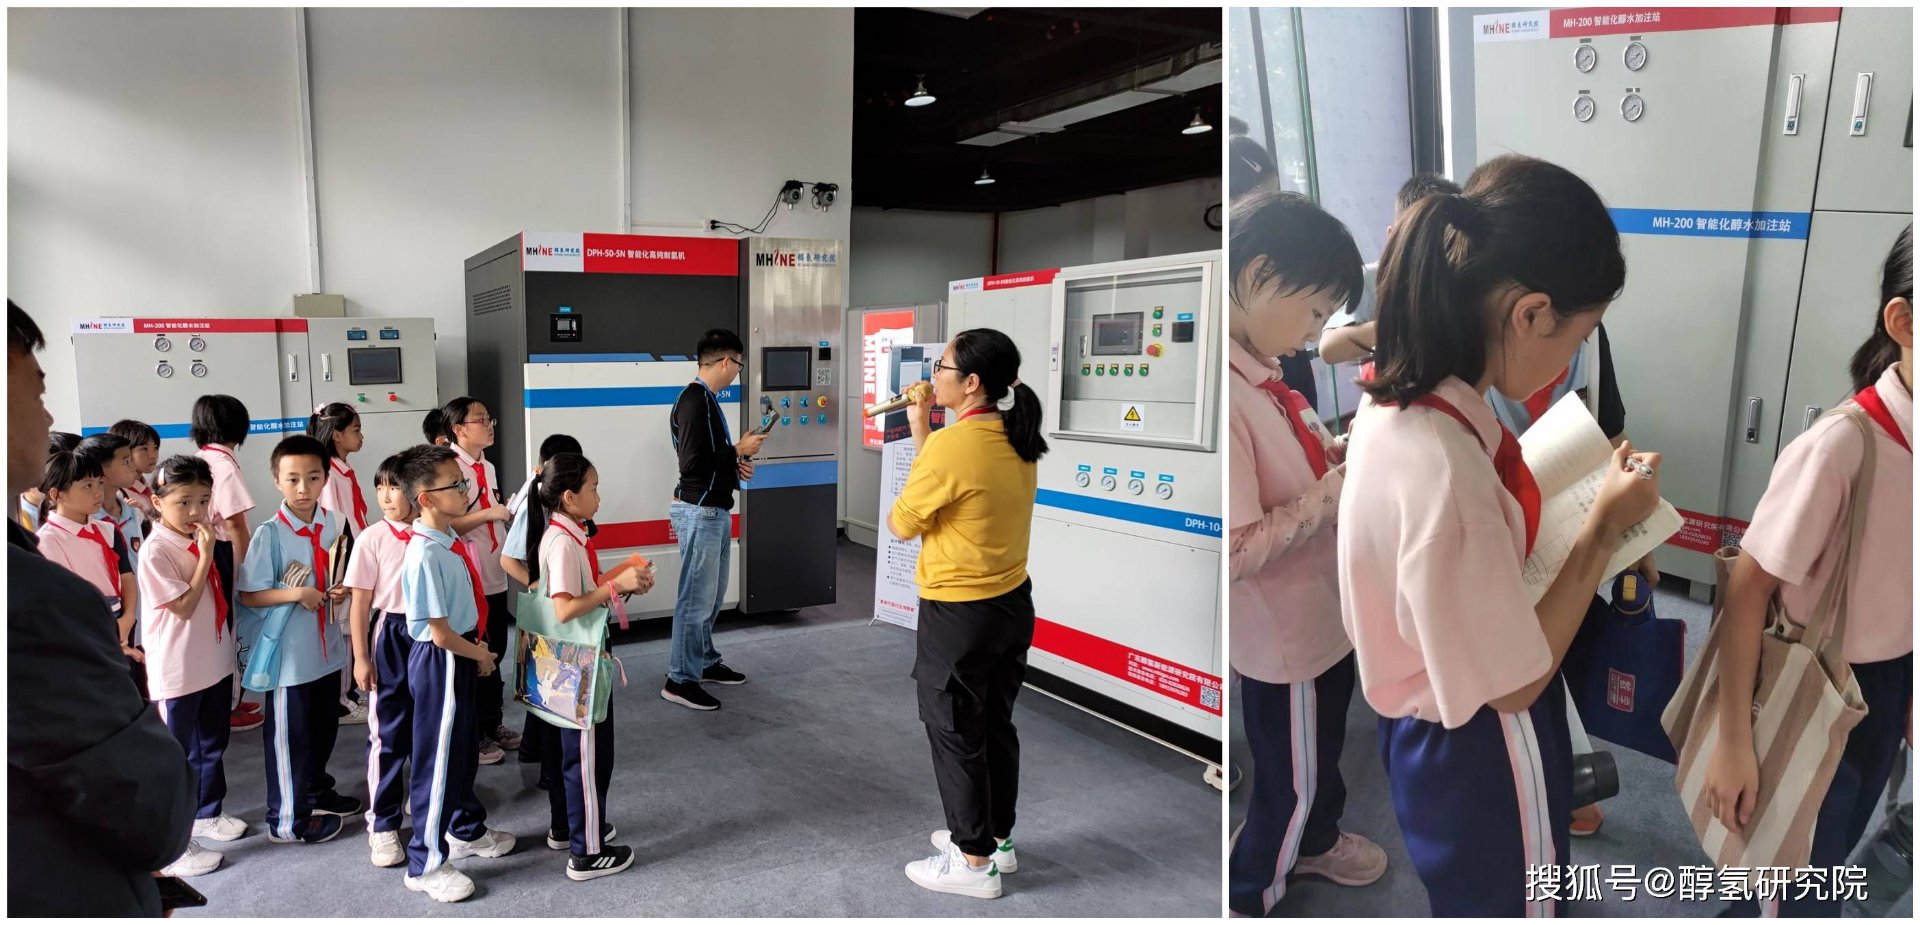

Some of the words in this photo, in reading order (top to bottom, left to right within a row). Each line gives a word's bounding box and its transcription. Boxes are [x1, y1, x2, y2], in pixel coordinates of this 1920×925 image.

[1562, 17, 1592, 28] MH-200
[1594, 12, 1661, 27] 智能化醇水加注站
[1652, 216, 1694, 229] MH-200
[1696, 217, 1792, 232] 智能化醇水加注站
[587, 248, 626, 258] DPH-50-5N
